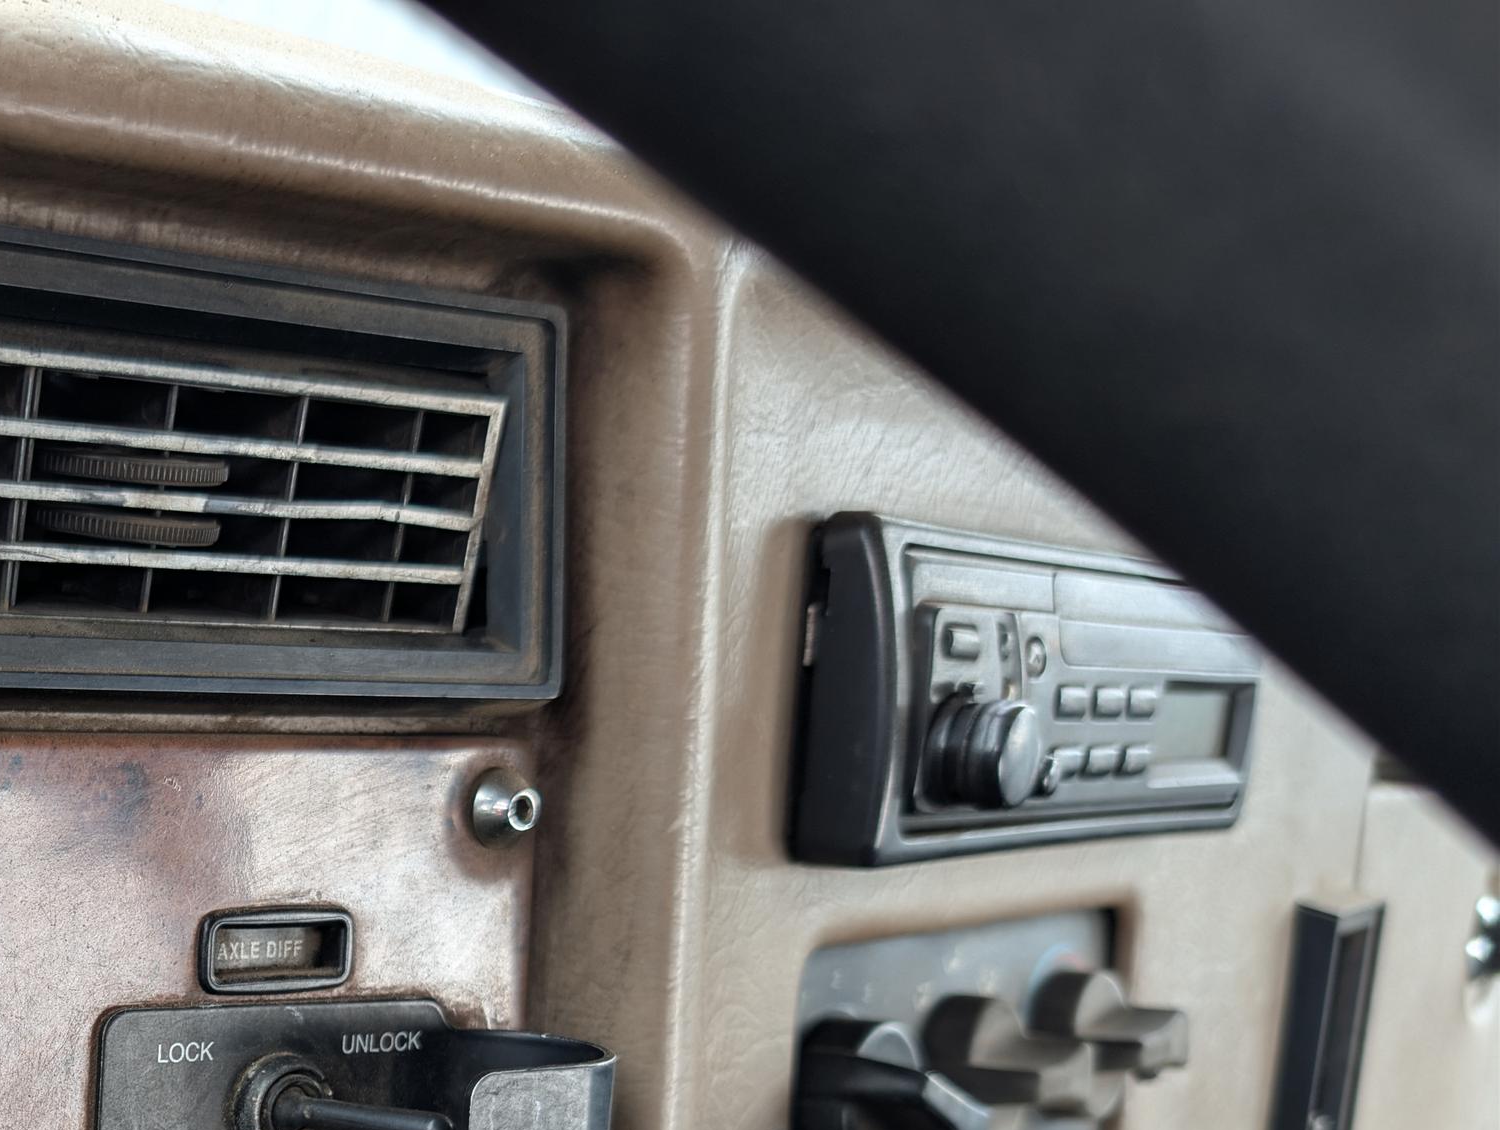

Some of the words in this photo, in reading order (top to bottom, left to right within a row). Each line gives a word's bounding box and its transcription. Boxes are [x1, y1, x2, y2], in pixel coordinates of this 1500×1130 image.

[217, 941, 260, 961] AXLE
[266, 940, 303, 959] DIFF
[157, 1042, 214, 1064] LOCK
[342, 1030, 421, 1055] UNLOCK
